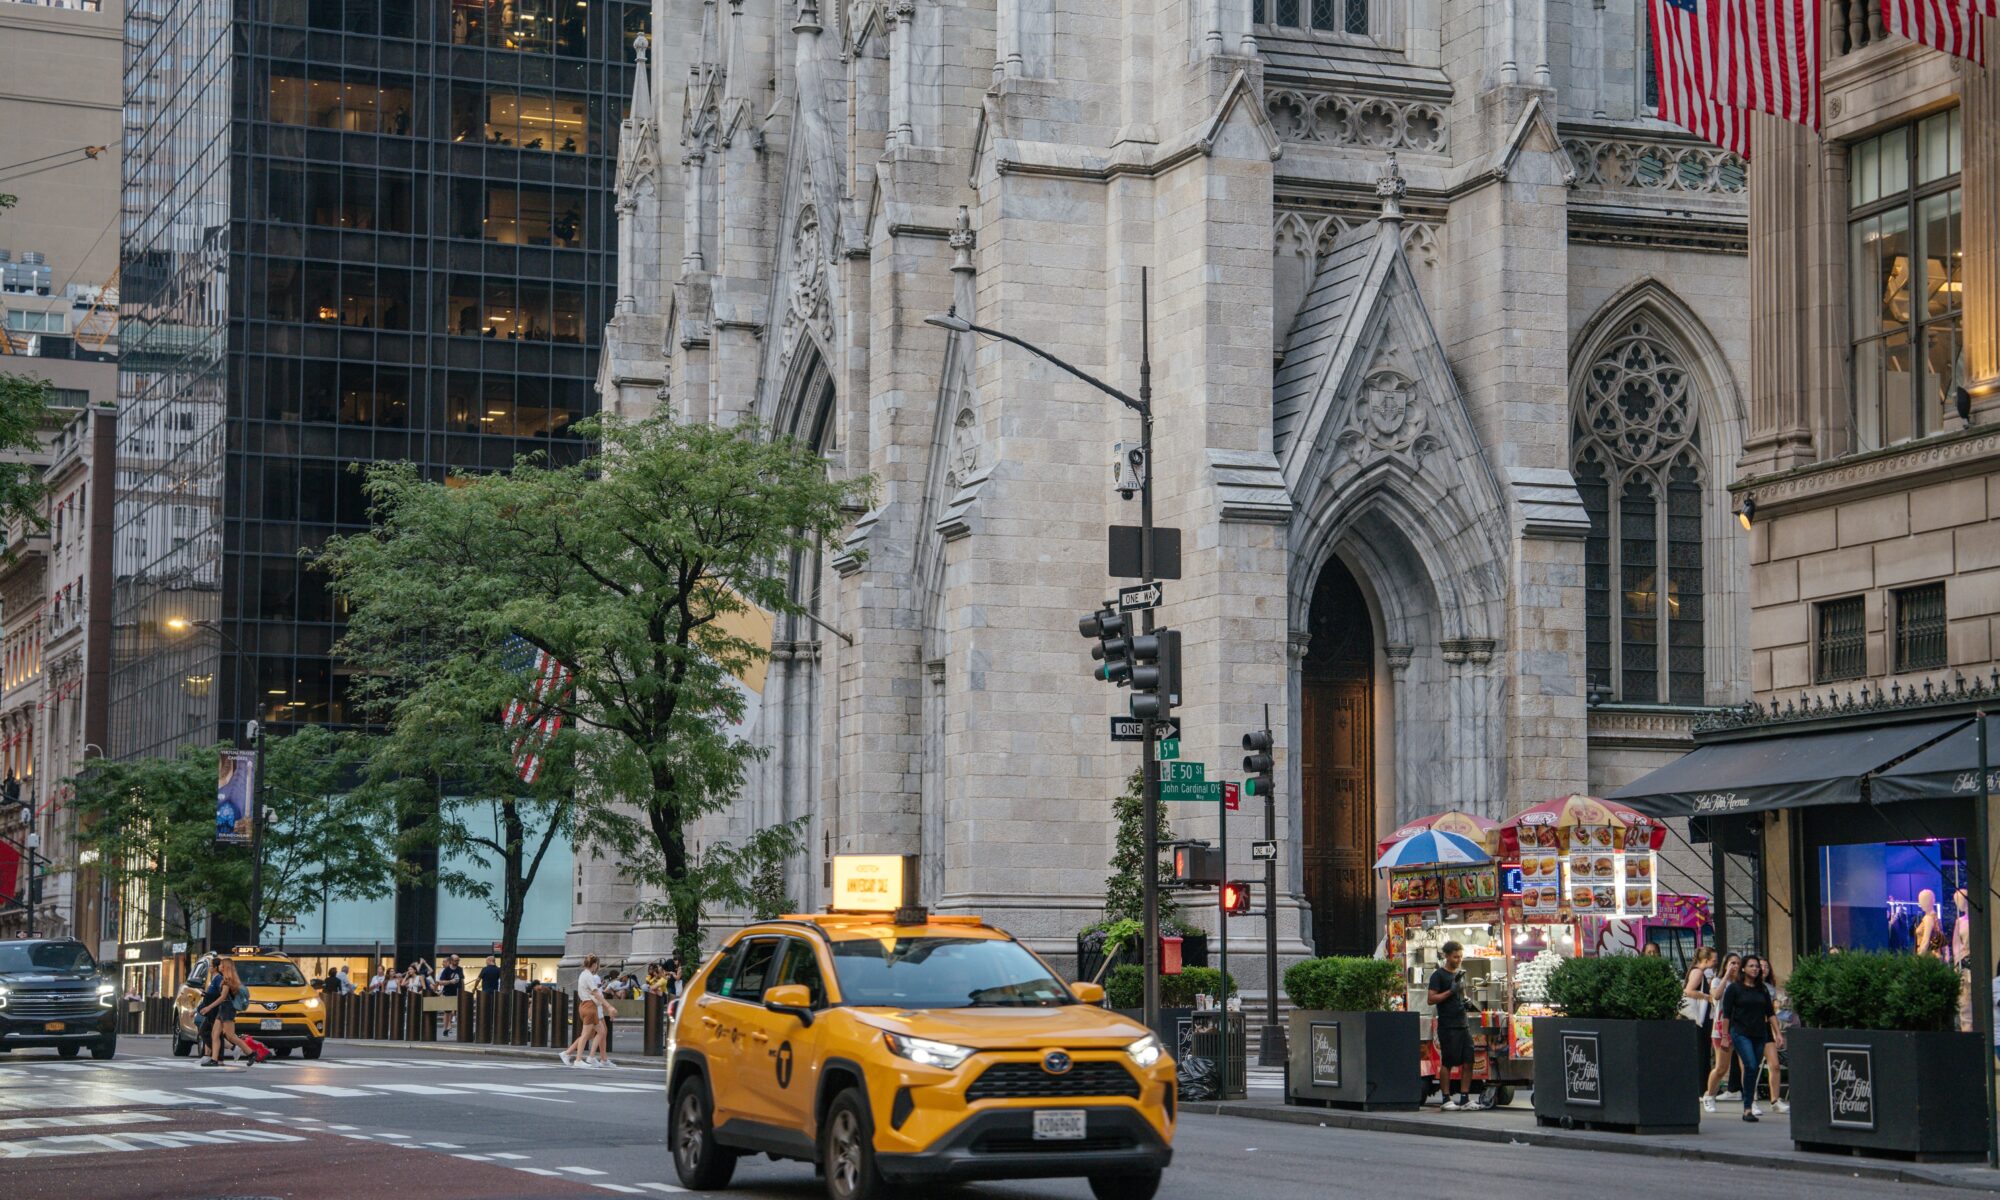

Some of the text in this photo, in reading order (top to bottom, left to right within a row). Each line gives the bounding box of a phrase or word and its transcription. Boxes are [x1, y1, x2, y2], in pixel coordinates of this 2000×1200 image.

[1125, 590, 1157, 604] ONE WAY
[1121, 724, 1141, 734] ONE
[1163, 742, 1168, 758] 5
[1171, 765, 1203, 779] E 50 St
[1162, 784, 1179, 793] John
[1181, 784, 1208, 793] Cardinal
[1693, 793, 1750, 812] Saks Fifth Avenue
[1255, 847, 1263, 855] ONE
[1566, 1044, 1586, 1067] Saks
[1577, 1061, 1598, 1080] Fifth
[1831, 1059, 1857, 1085] Saks
[1566, 1071, 1597, 1093] Avenue
[1844, 1077, 1871, 1101] Fifth
[1832, 1088, 1869, 1114] Avenue
